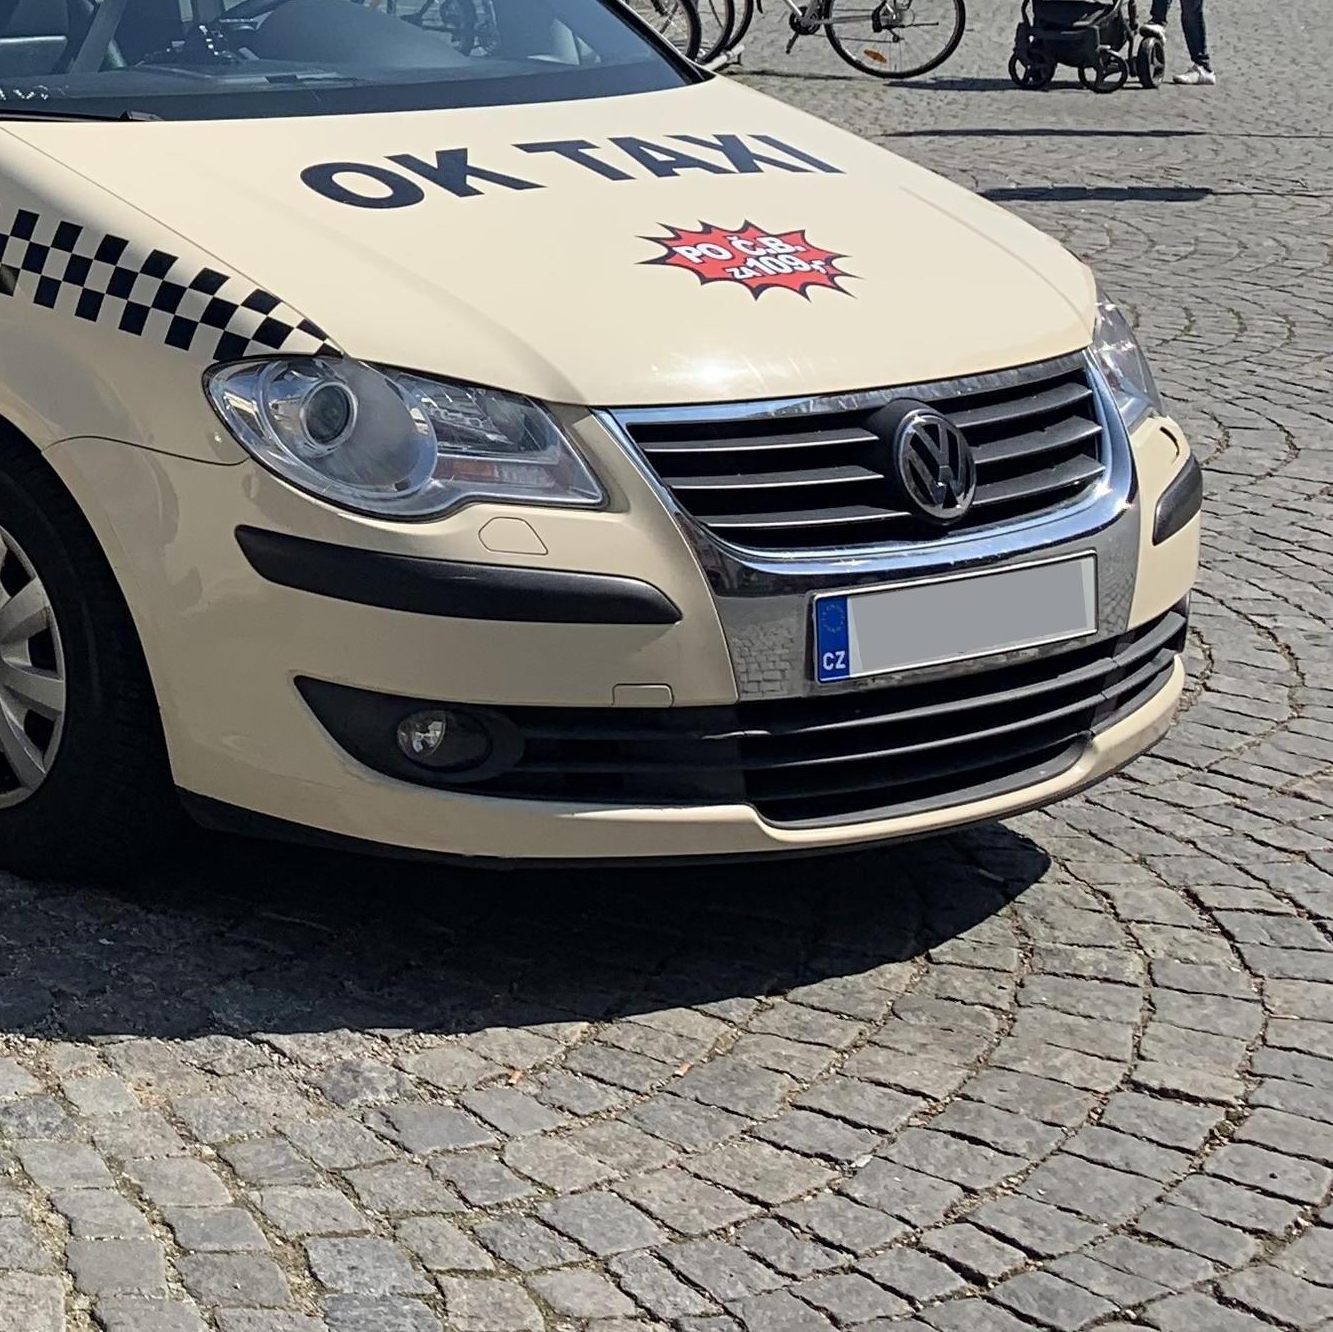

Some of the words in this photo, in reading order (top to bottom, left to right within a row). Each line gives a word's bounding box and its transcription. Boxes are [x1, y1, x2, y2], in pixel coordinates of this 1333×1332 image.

[299, 147, 547, 209] OK
[511, 133, 847, 182] TAXI
[672, 242, 733, 264] PO
[822, 650, 847, 671] CZ
